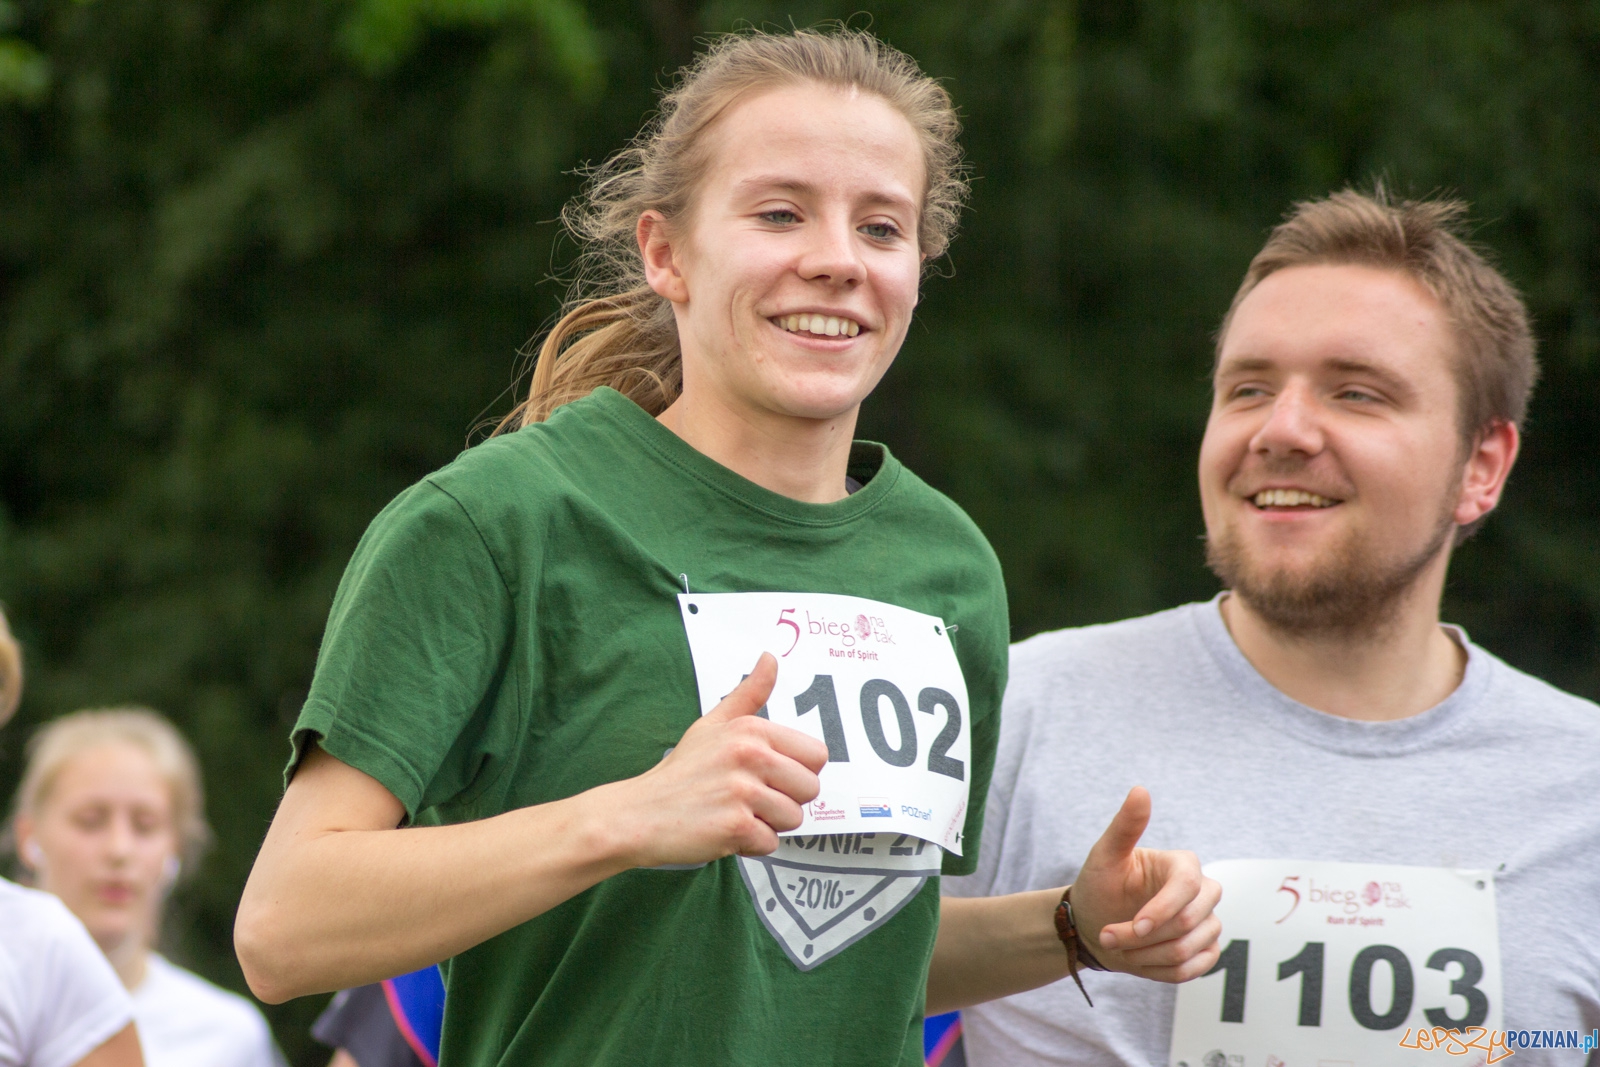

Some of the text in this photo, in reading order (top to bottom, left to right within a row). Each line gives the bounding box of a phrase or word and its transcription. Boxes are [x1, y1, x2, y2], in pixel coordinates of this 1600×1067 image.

[776, 608, 885, 658] 5 bieg na
[873, 629, 896, 645] tak
[829, 648, 879, 661] Run of Spirit
[1275, 876, 1300, 924] 5
[1309, 878, 1360, 914] bieg
[1327, 915, 1384, 927] Run of Spirit
[1200, 938, 1490, 1034] 1103
